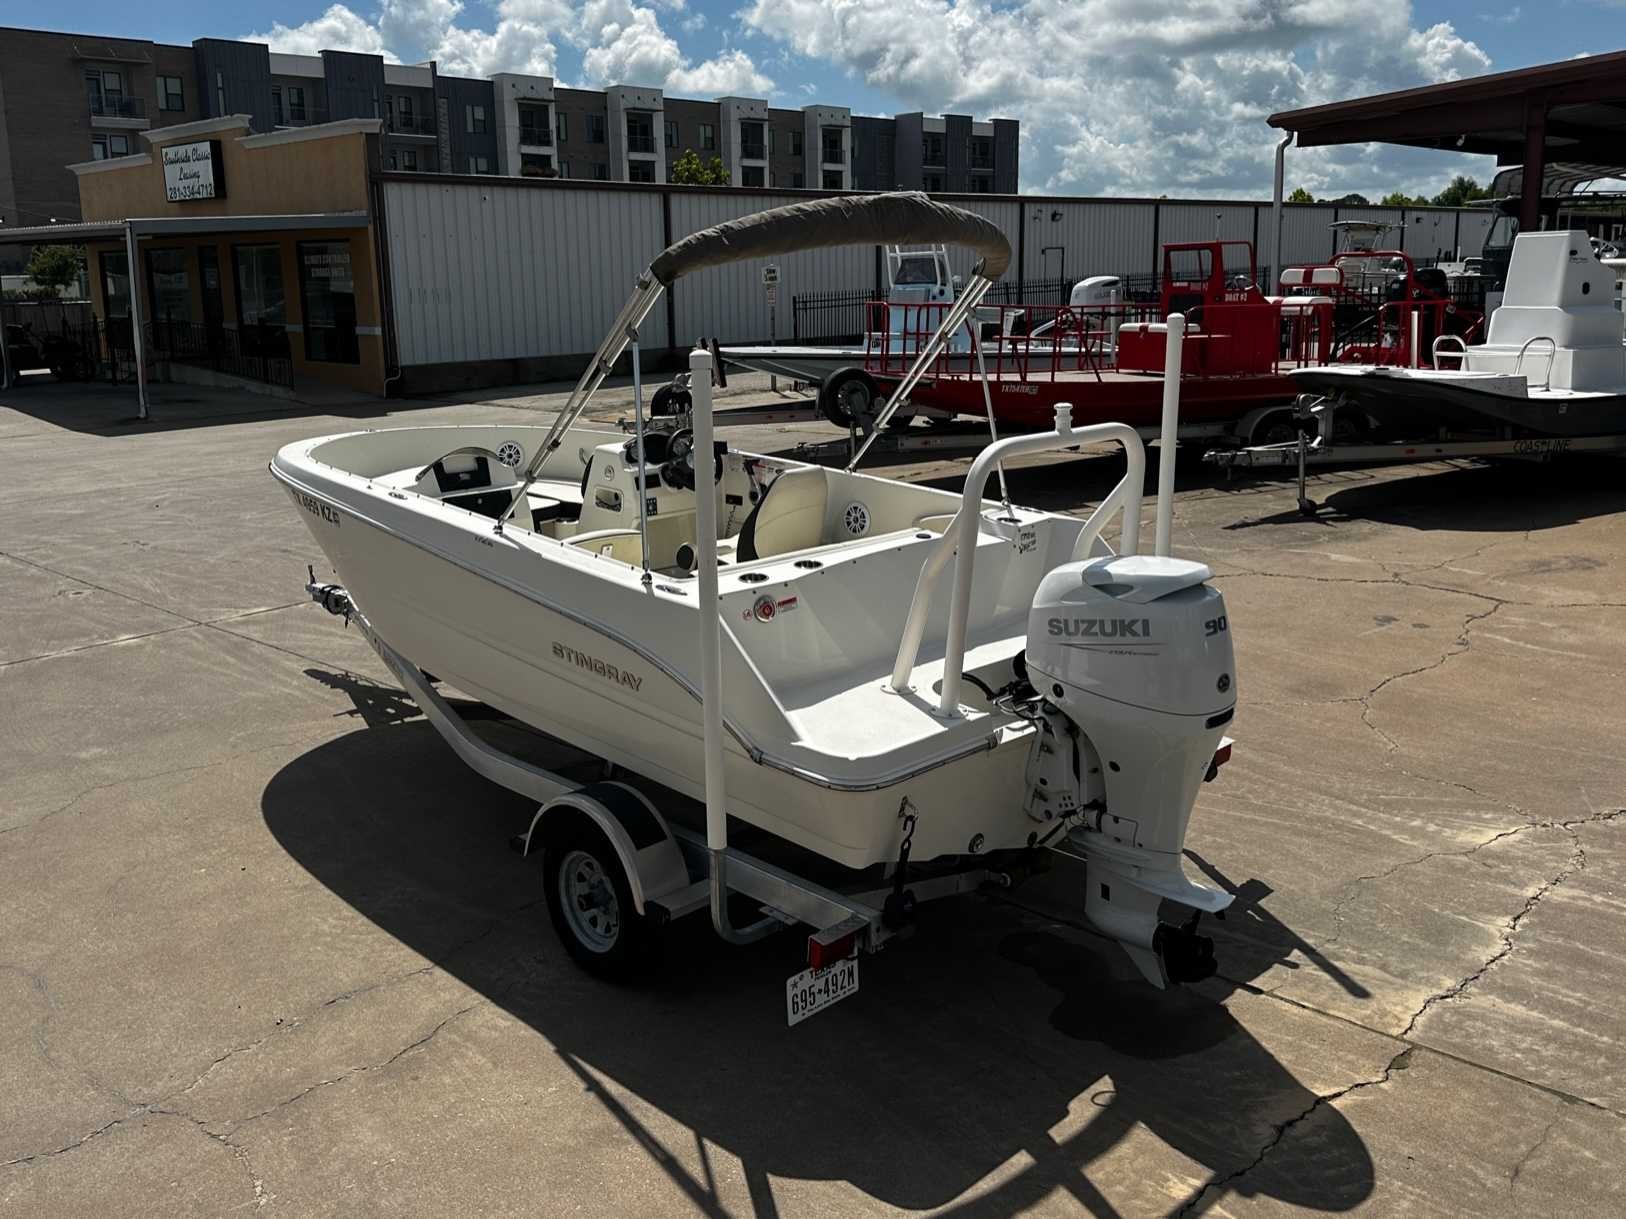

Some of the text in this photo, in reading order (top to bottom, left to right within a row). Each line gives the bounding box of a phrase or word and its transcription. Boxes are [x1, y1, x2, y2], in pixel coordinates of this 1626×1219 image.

[178, 166, 201, 183] Leasing
[1047, 615, 1227, 638] SUZUKI 90
[552, 641, 643, 692] STINGRAY
